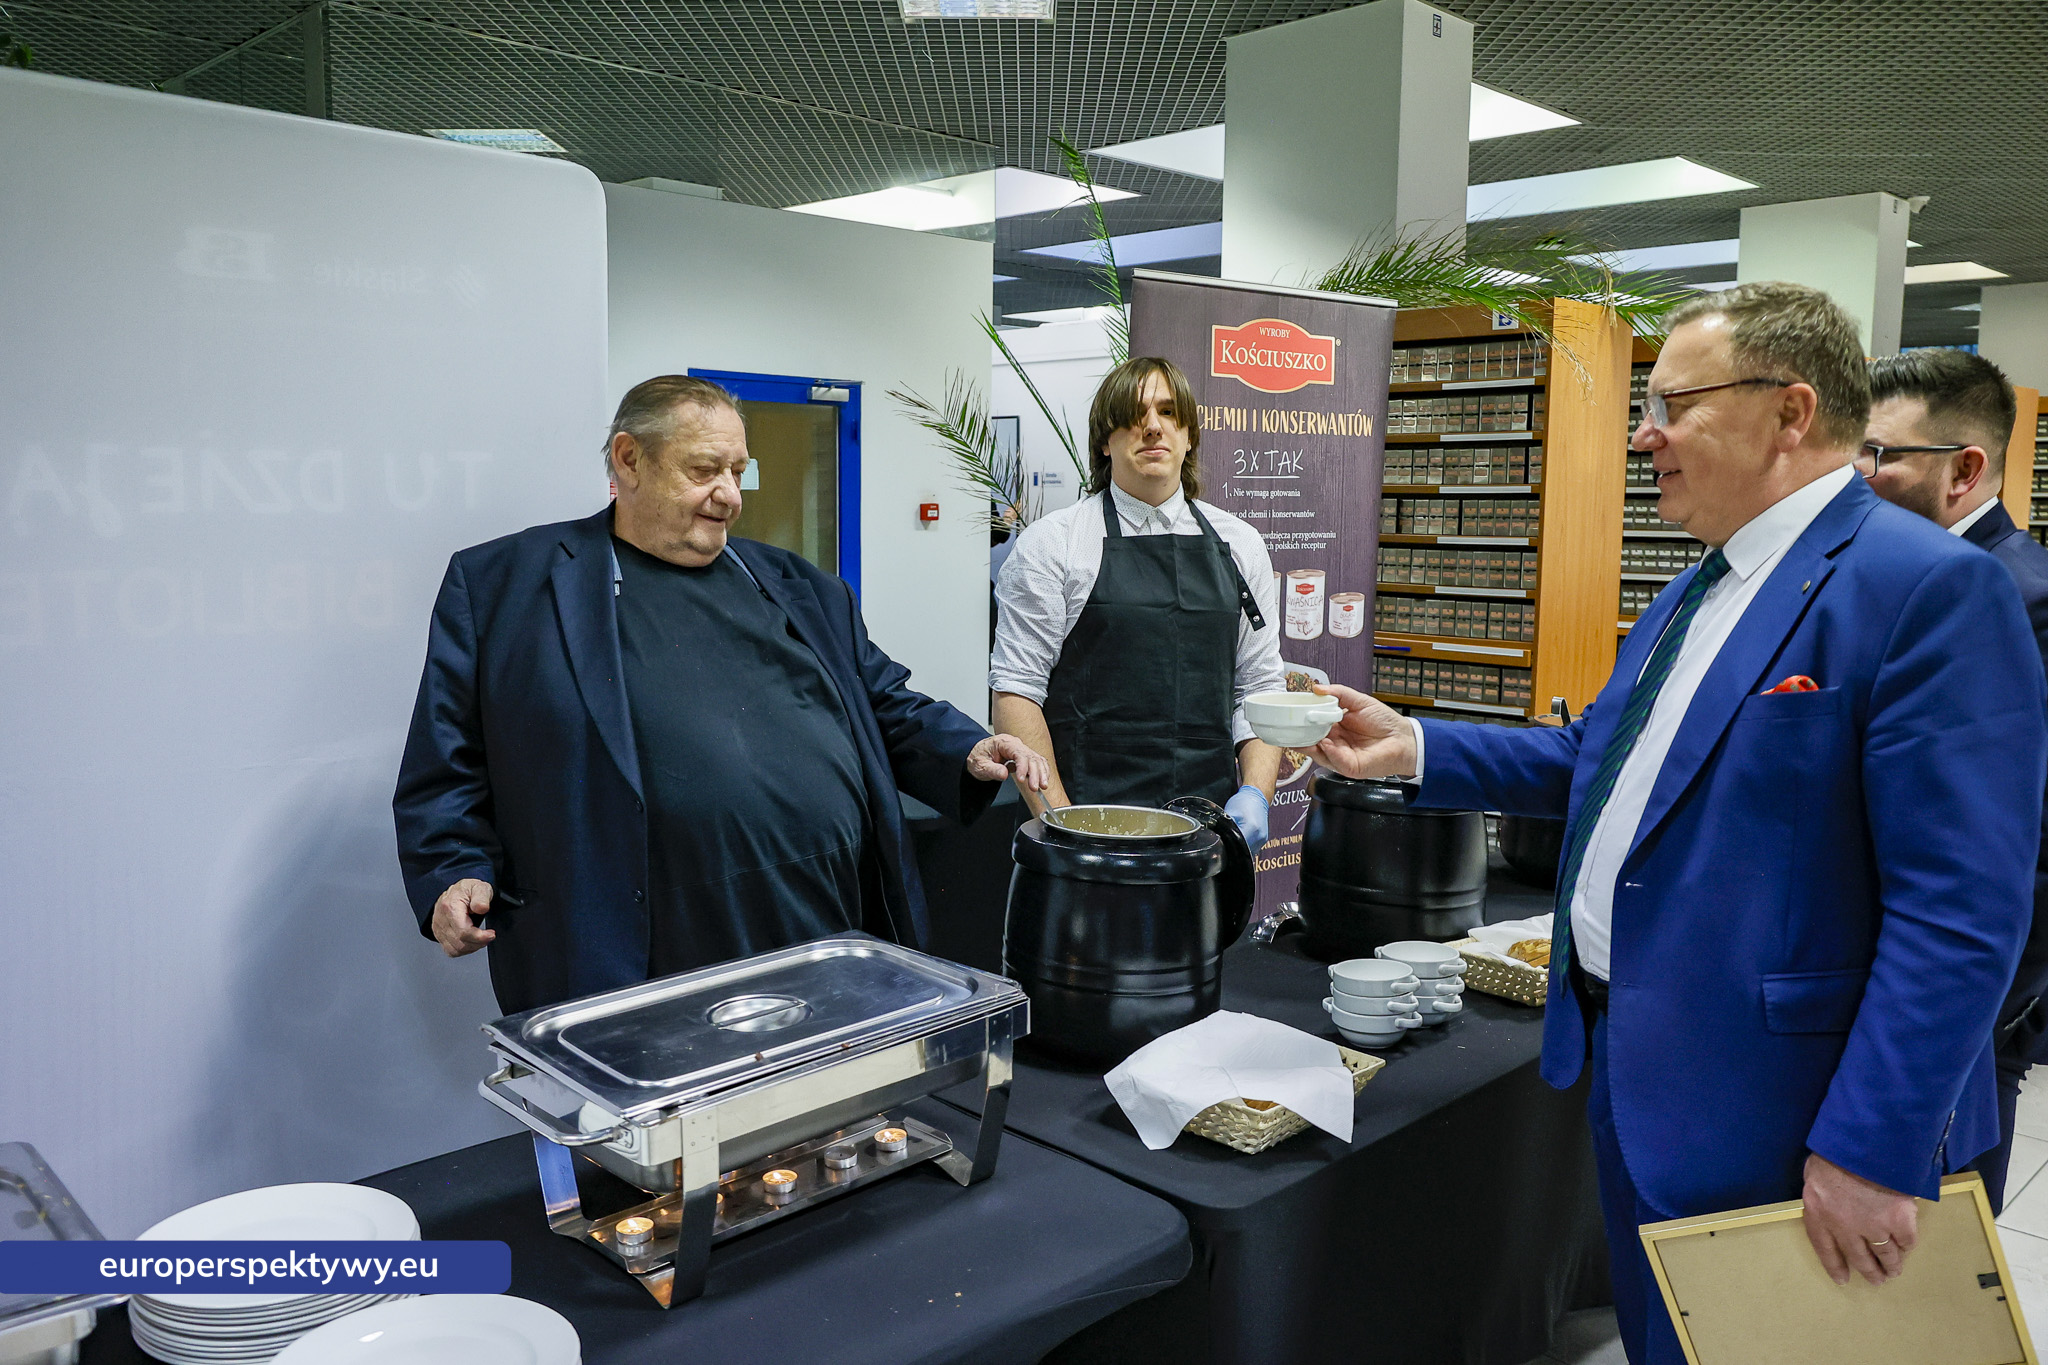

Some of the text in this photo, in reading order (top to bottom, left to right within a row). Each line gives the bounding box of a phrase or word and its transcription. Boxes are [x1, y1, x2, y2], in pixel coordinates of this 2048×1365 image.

[1259, 327, 1290, 338] WYROBY
[1220, 339, 1326, 371] KOŚCIUSZKO
[1196, 405, 1374, 437] CHEMII I KONSERWANTÓW
[1264, 449, 1304, 475] TAK
[1233, 488, 1245, 497] Nie
[1246, 489, 1270, 499] wymaga
[1270, 487, 1301, 499] gotowania
[1248, 509, 1268, 518] chemii
[1271, 509, 1315, 518] konserwantów
[1291, 530, 1337, 541] przygotowaniu
[1275, 541, 1300, 552] polskich
[1301, 541, 1327, 551] receptur
